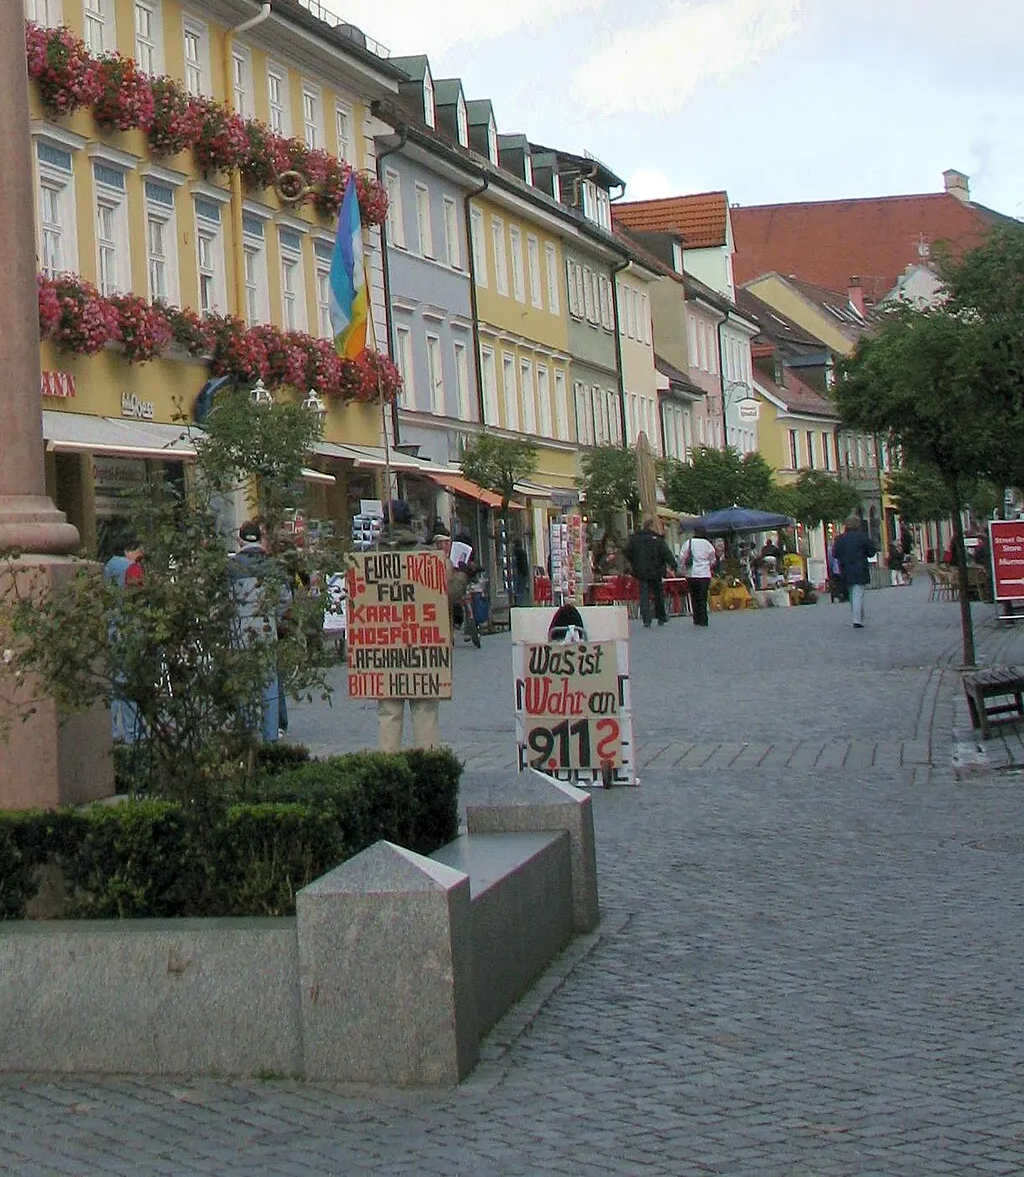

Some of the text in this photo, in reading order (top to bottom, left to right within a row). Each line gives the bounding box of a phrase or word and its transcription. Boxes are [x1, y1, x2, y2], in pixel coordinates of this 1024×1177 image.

[377, 580, 415, 601] FÜR
[349, 603, 416, 623] KARLA
[529, 645, 603, 676] Was ist
[525, 677, 617, 716] Wahr an
